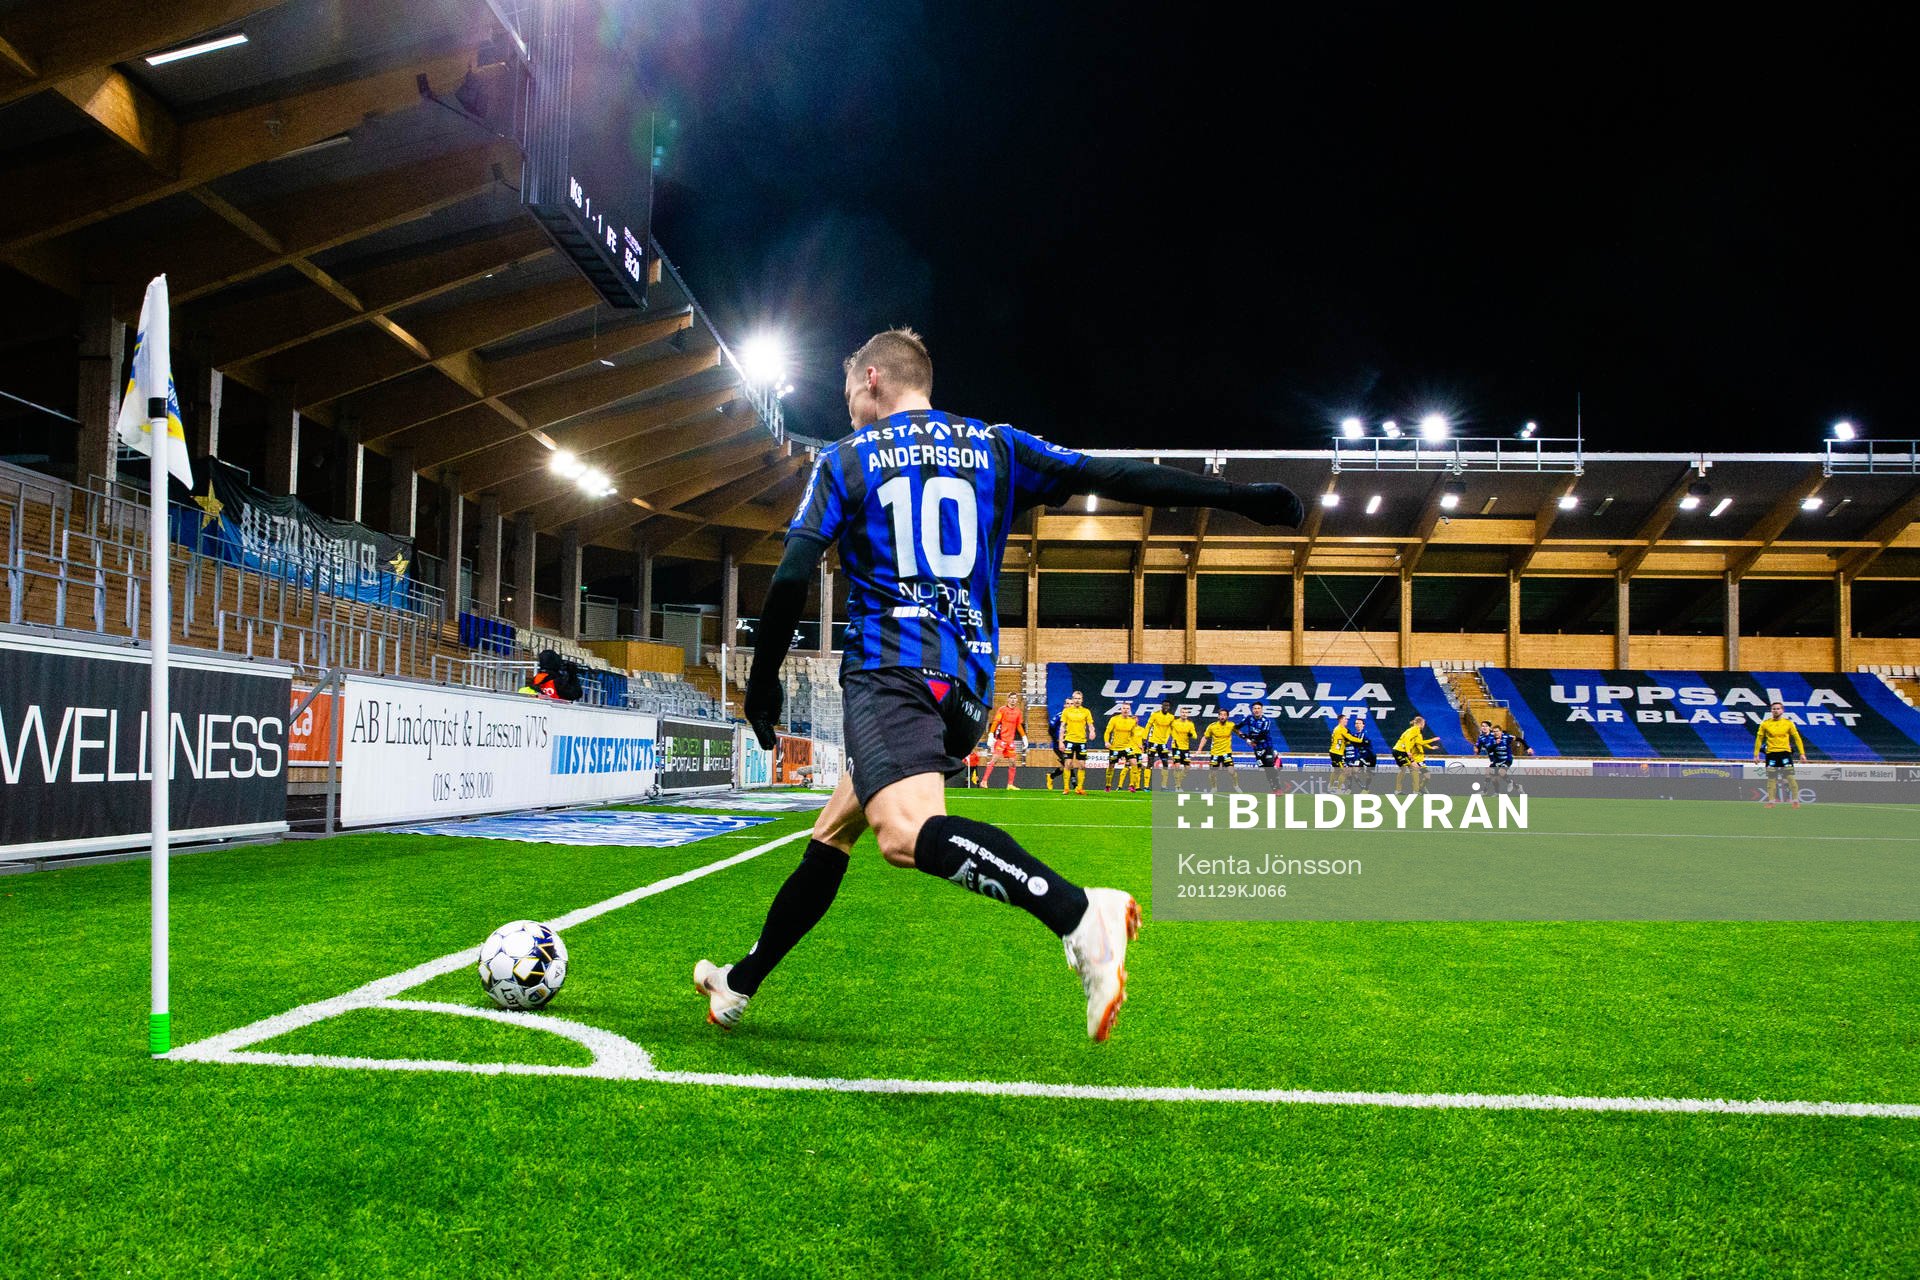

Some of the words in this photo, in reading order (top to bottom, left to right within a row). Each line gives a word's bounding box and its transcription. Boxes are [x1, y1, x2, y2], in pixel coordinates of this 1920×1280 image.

[586, 198, 590, 218] 1
[598, 214, 602, 234] 1
[952, 424, 996, 441] TAK
[868, 444, 989, 473] ANDERSSON
[876, 476, 978, 578] 10
[1100, 679, 1393, 701] UPPSALA
[1550, 685, 1852, 708] UPPSALA
[1566, 706, 1624, 723] ÄR
[350, 699, 380, 744] AB
[385, 701, 459, 760] Lindqvist
[463, 710, 473, 747] &
[476, 711, 522, 748] Larsson
[526, 715, 548, 749] VVS
[1524, 767, 1565, 777] VIKING
[1567, 768, 1590, 777] LINE
[432, 772, 450, 801] 018
[458, 772, 476, 800] 388
[477, 772, 494, 799] 000
[948, 834, 980, 855] Motor
[978, 846, 1029, 884] Upplands
